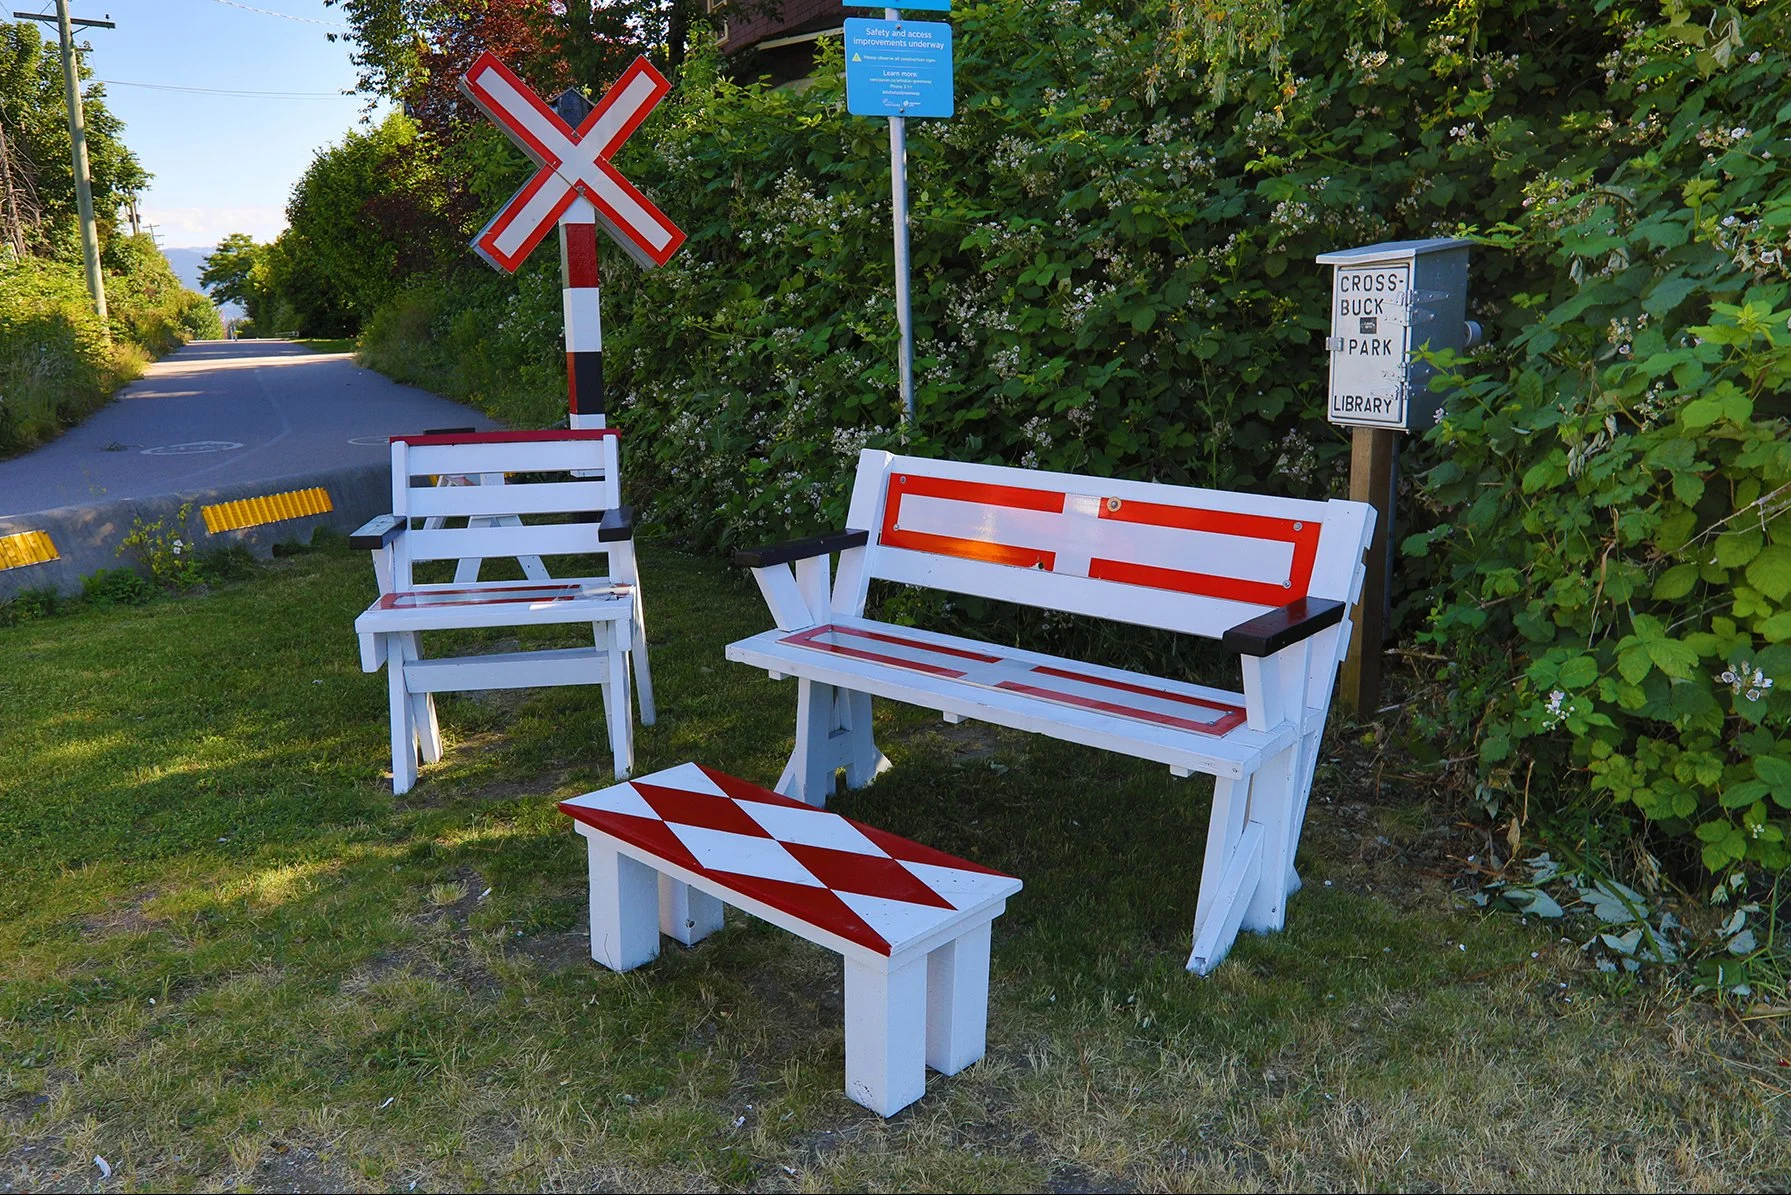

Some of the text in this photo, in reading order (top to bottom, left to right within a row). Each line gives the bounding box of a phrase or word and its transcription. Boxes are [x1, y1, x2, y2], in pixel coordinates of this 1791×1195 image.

[866, 28, 890, 37] Safety
[908, 31, 932, 39] access
[853, 37, 944, 50] improvements underway
[1341, 298, 1384, 316] BUCK
[1349, 339, 1392, 356] PARK
[1333, 395, 1392, 414] LIBRARY
